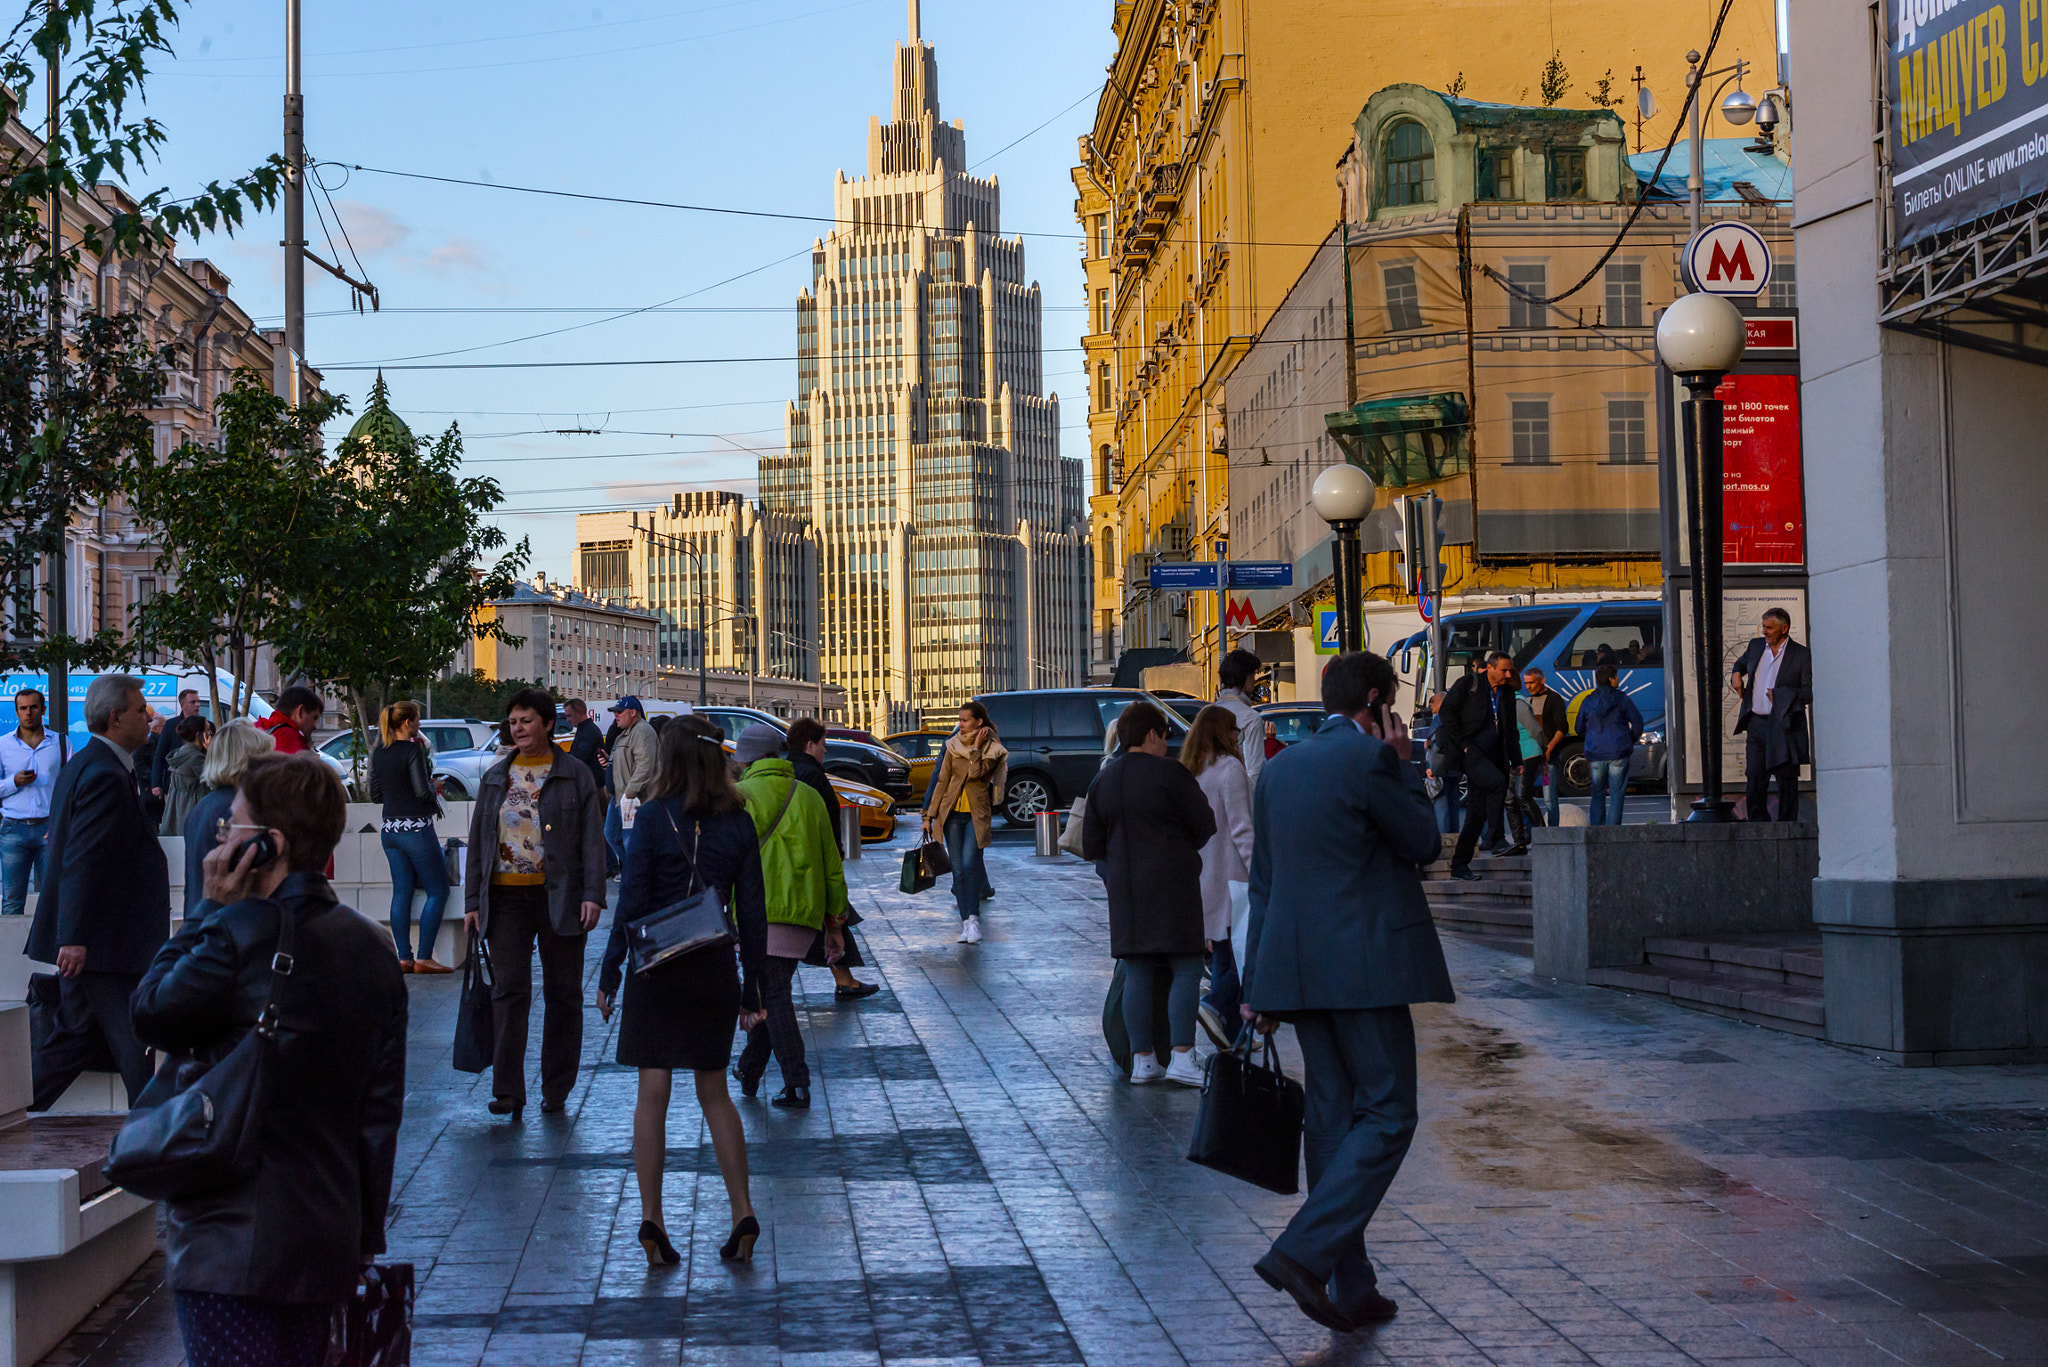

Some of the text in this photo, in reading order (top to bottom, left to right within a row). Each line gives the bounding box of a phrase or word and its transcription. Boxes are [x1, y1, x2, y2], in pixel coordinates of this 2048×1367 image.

[1899, 4, 2007, 147] МАЦУЕВ
[1904, 132, 2048, 216] Билеты ONLINE www.melo
[1706, 238, 1755, 284] М
[1747, 329, 1766, 338] КАЯ
[1738, 413, 1775, 422] билетов
[1740, 402, 1763, 411] 1800
